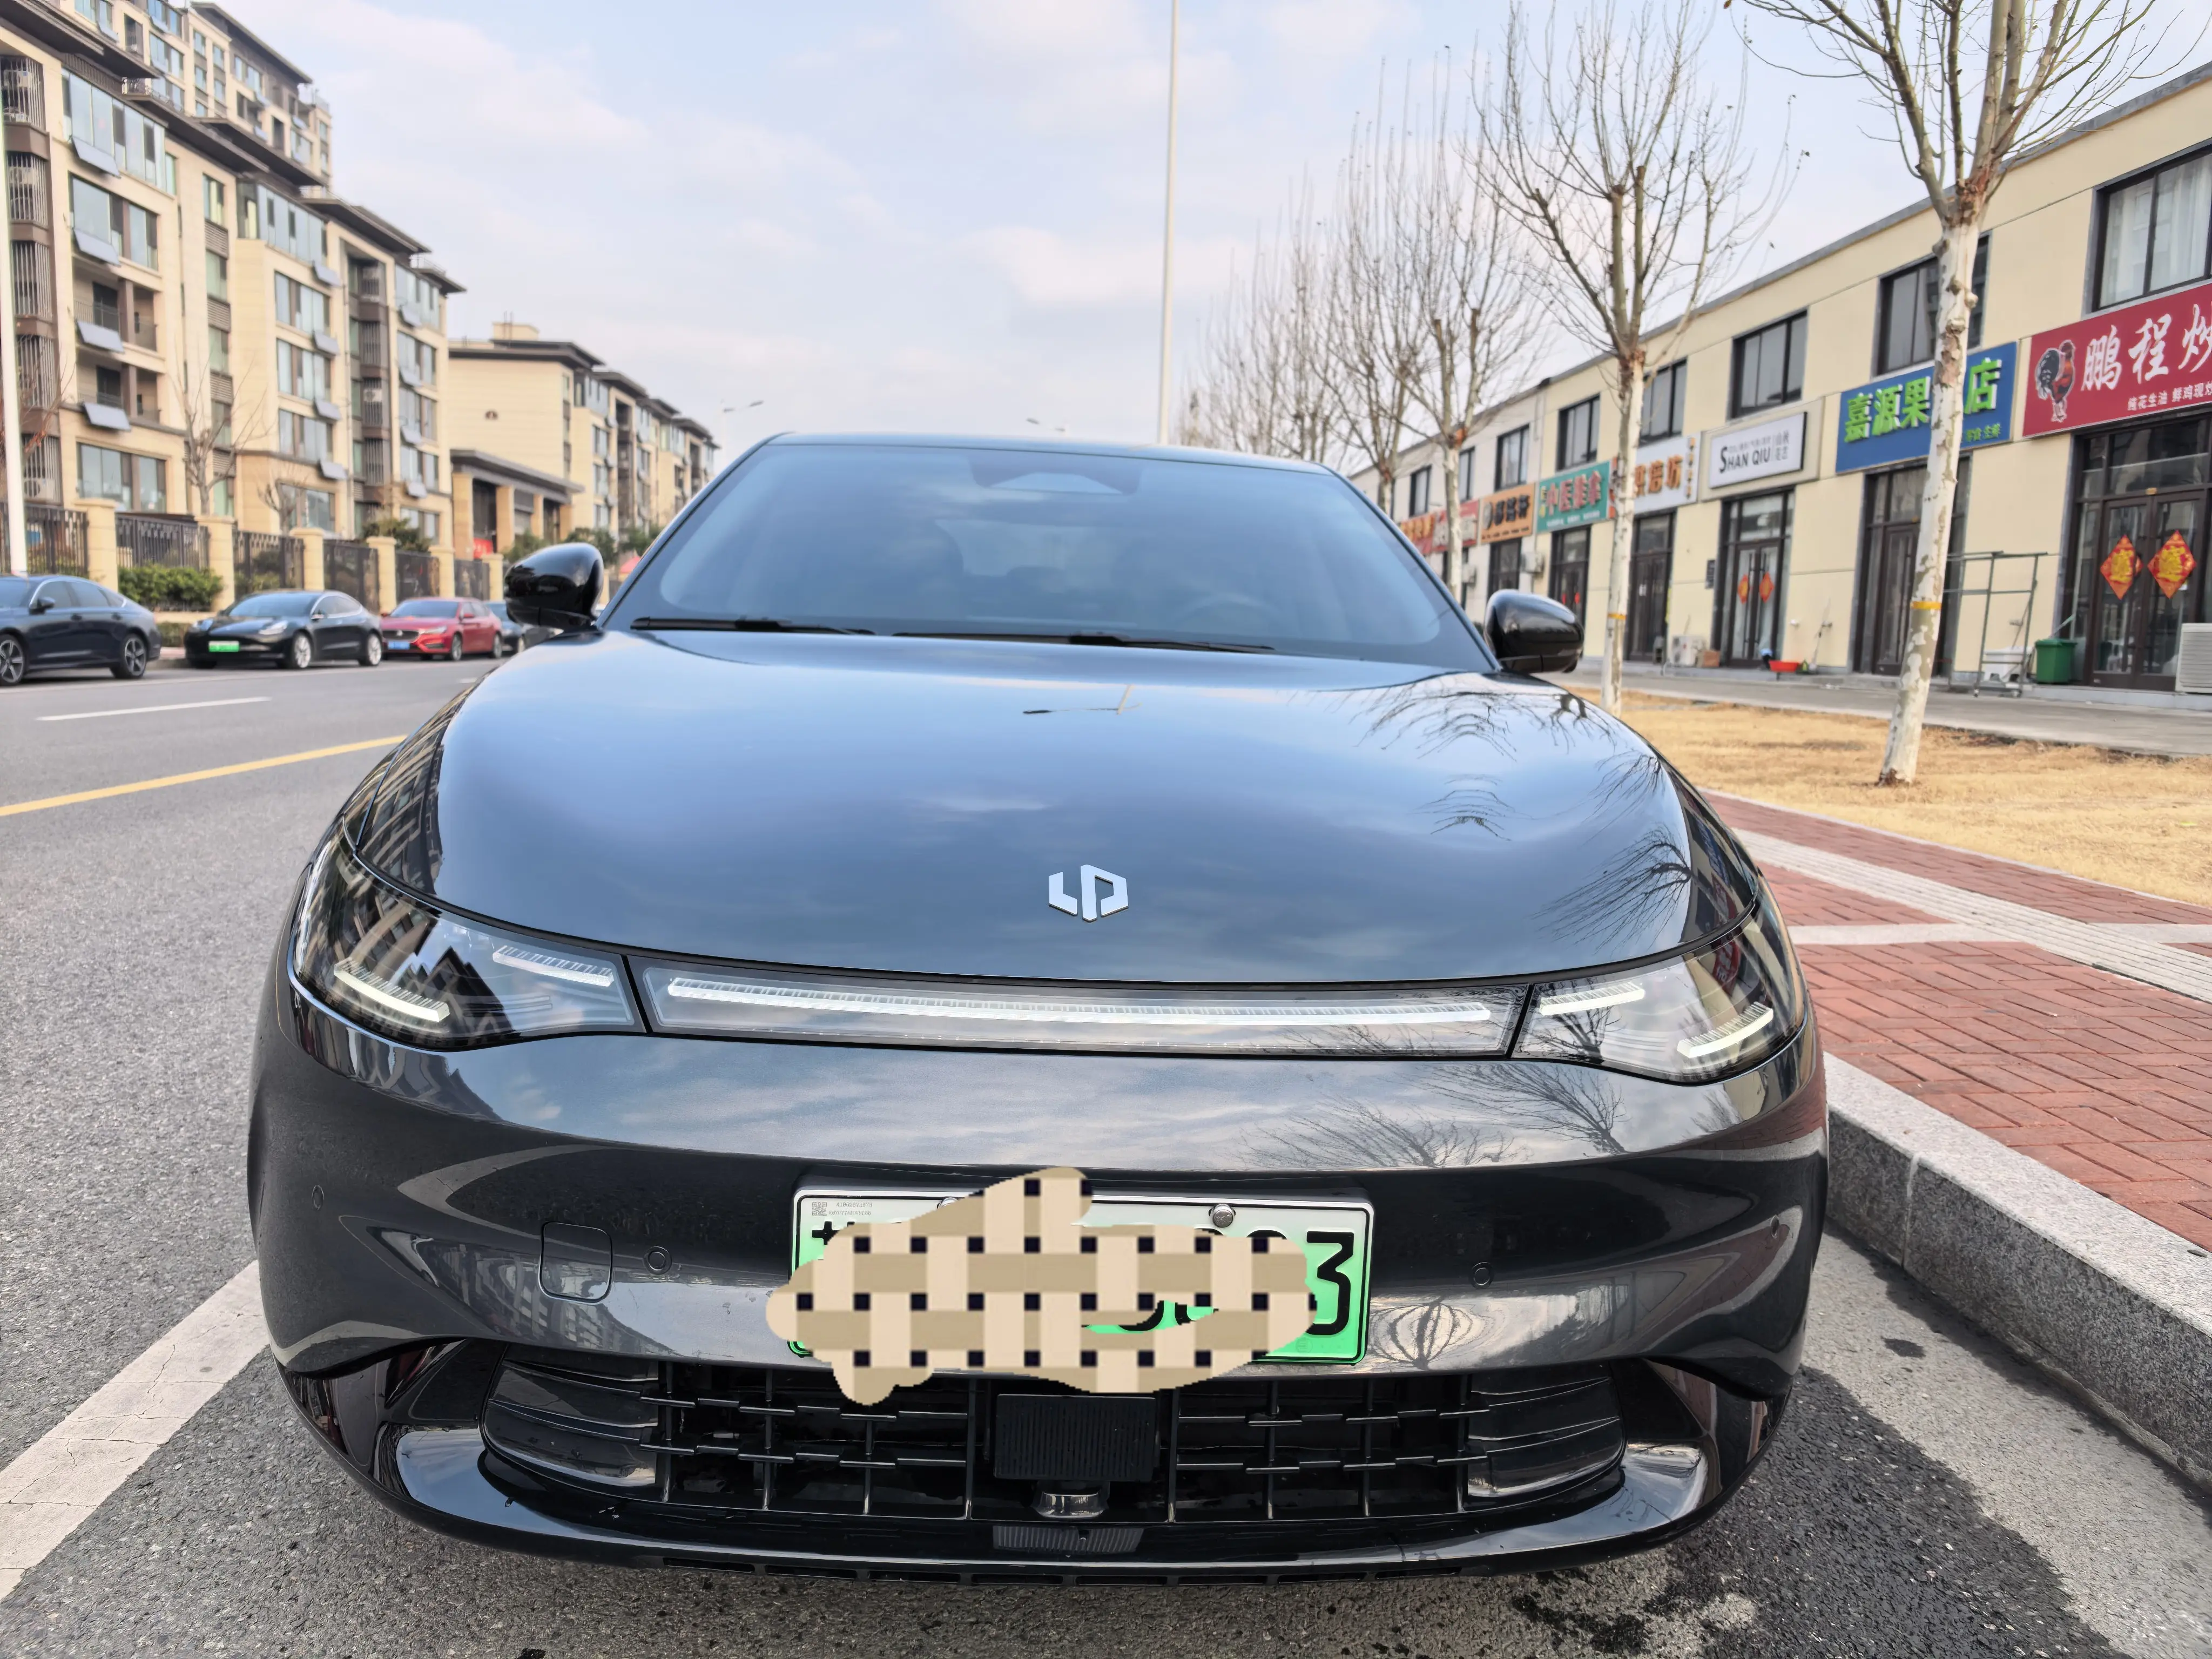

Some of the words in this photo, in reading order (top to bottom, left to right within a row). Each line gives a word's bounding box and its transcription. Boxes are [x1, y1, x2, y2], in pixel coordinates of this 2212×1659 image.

[1844, 357, 2002, 443] 嘉源果店
[1719, 446, 1749, 474] SHAN
[1752, 448, 1771, 466] QIU
